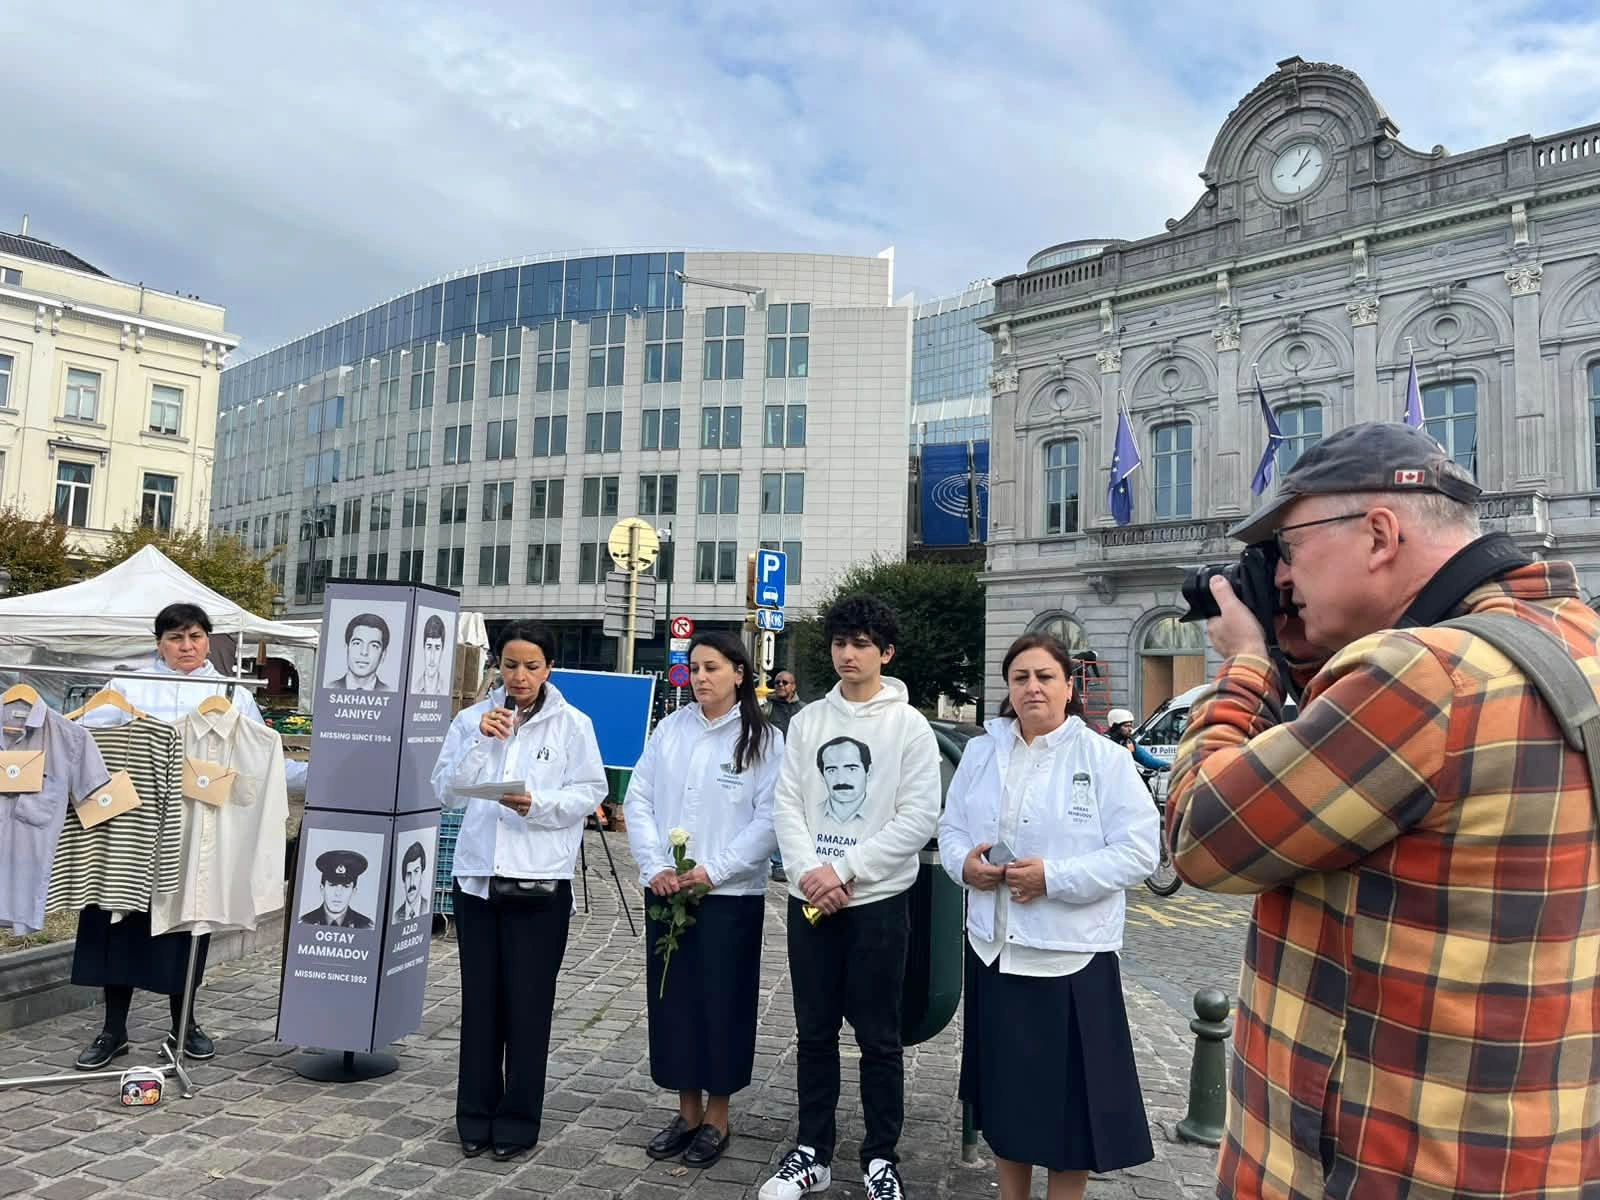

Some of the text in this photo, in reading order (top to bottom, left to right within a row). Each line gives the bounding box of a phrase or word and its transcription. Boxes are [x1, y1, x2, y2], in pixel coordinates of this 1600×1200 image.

[763, 554, 780, 583] P
[329, 694, 390, 707] SAKHAVAT
[334, 708, 381, 721] JANIYEV
[320, 731, 351, 741] MISSING
[352, 732, 374, 742] SINCE
[402, 922, 418, 936] AZAD
[315, 930, 355, 944] OGTAY
[392, 933, 424, 953] JABBAROV
[297, 944, 369, 961] MAMMADOV
[294, 969, 368, 984] MISSING SINCE 1992
